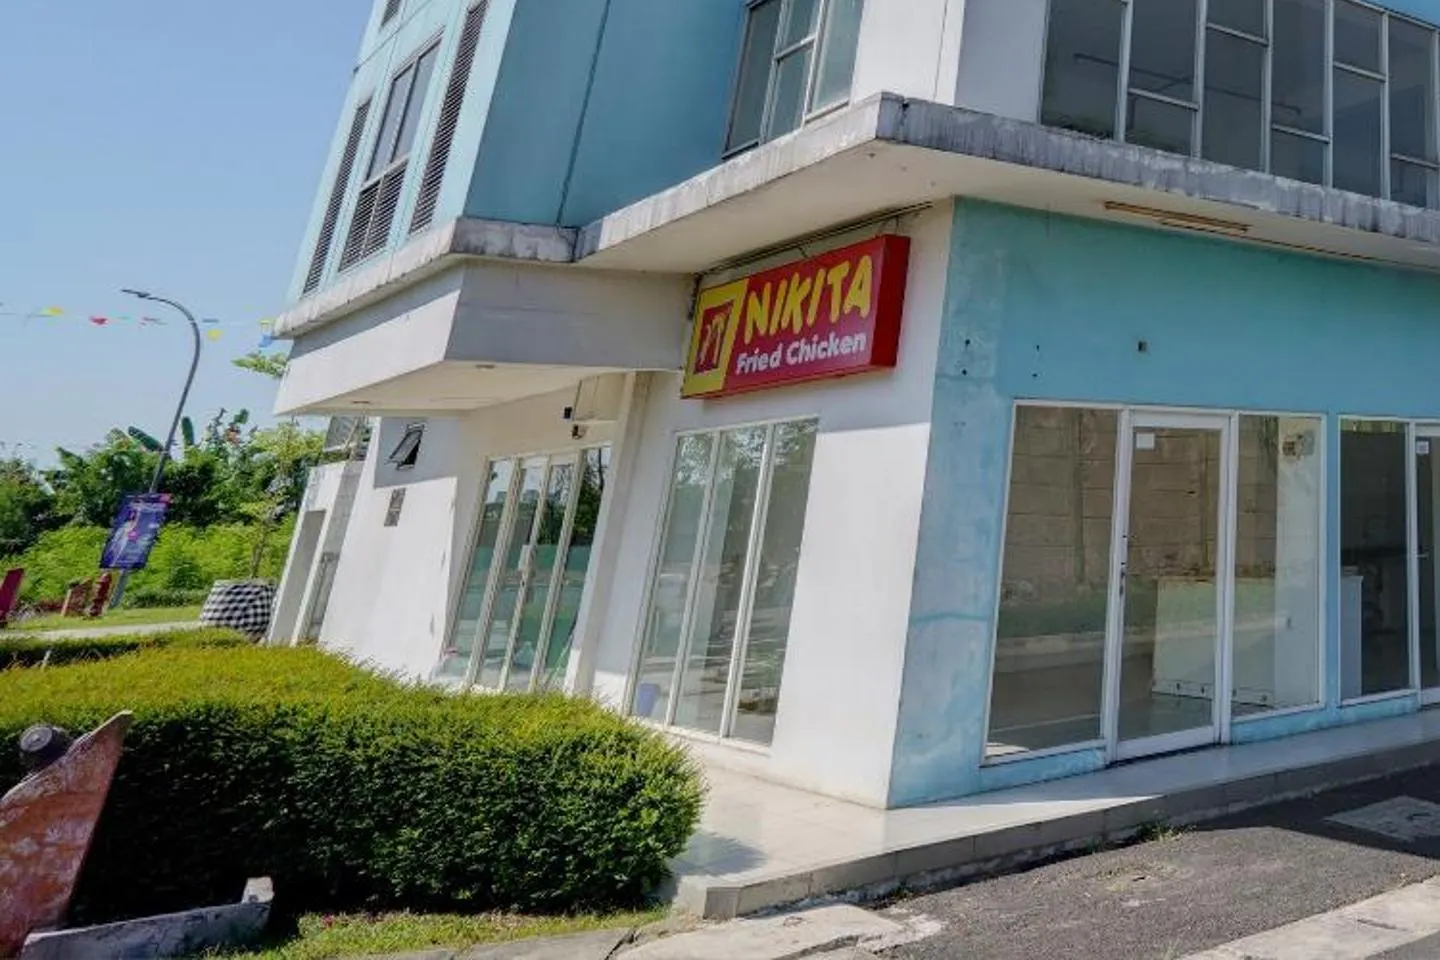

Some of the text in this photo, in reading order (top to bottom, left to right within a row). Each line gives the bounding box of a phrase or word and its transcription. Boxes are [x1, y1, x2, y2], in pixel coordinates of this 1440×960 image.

[744, 255, 873, 345] NIKITA
[736, 331, 867, 375] Fried Chicken
